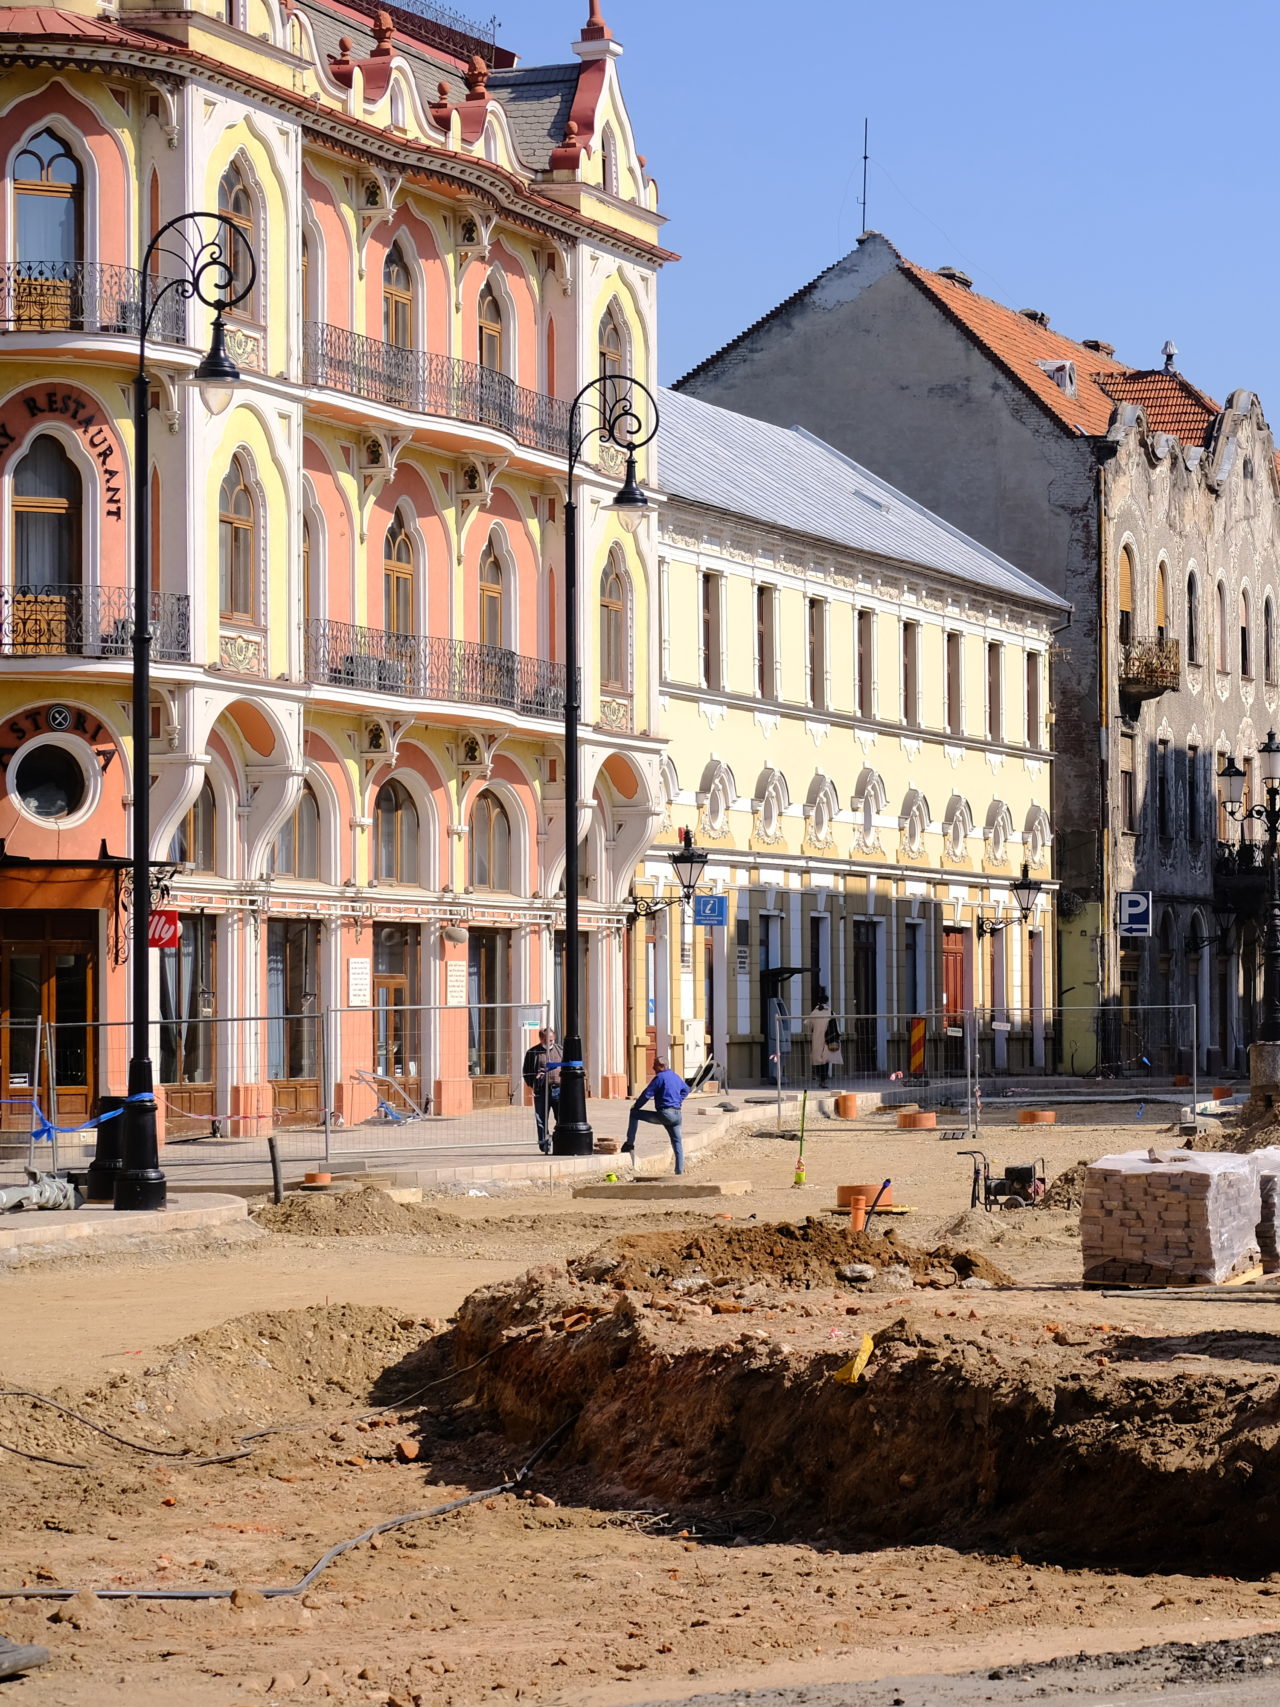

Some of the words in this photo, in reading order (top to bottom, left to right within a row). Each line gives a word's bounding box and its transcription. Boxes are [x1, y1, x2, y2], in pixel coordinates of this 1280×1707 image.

[23, 392, 121, 522] RESTAURANT
[1121, 893, 1148, 924] P
[149, 915, 175, 945] lly
